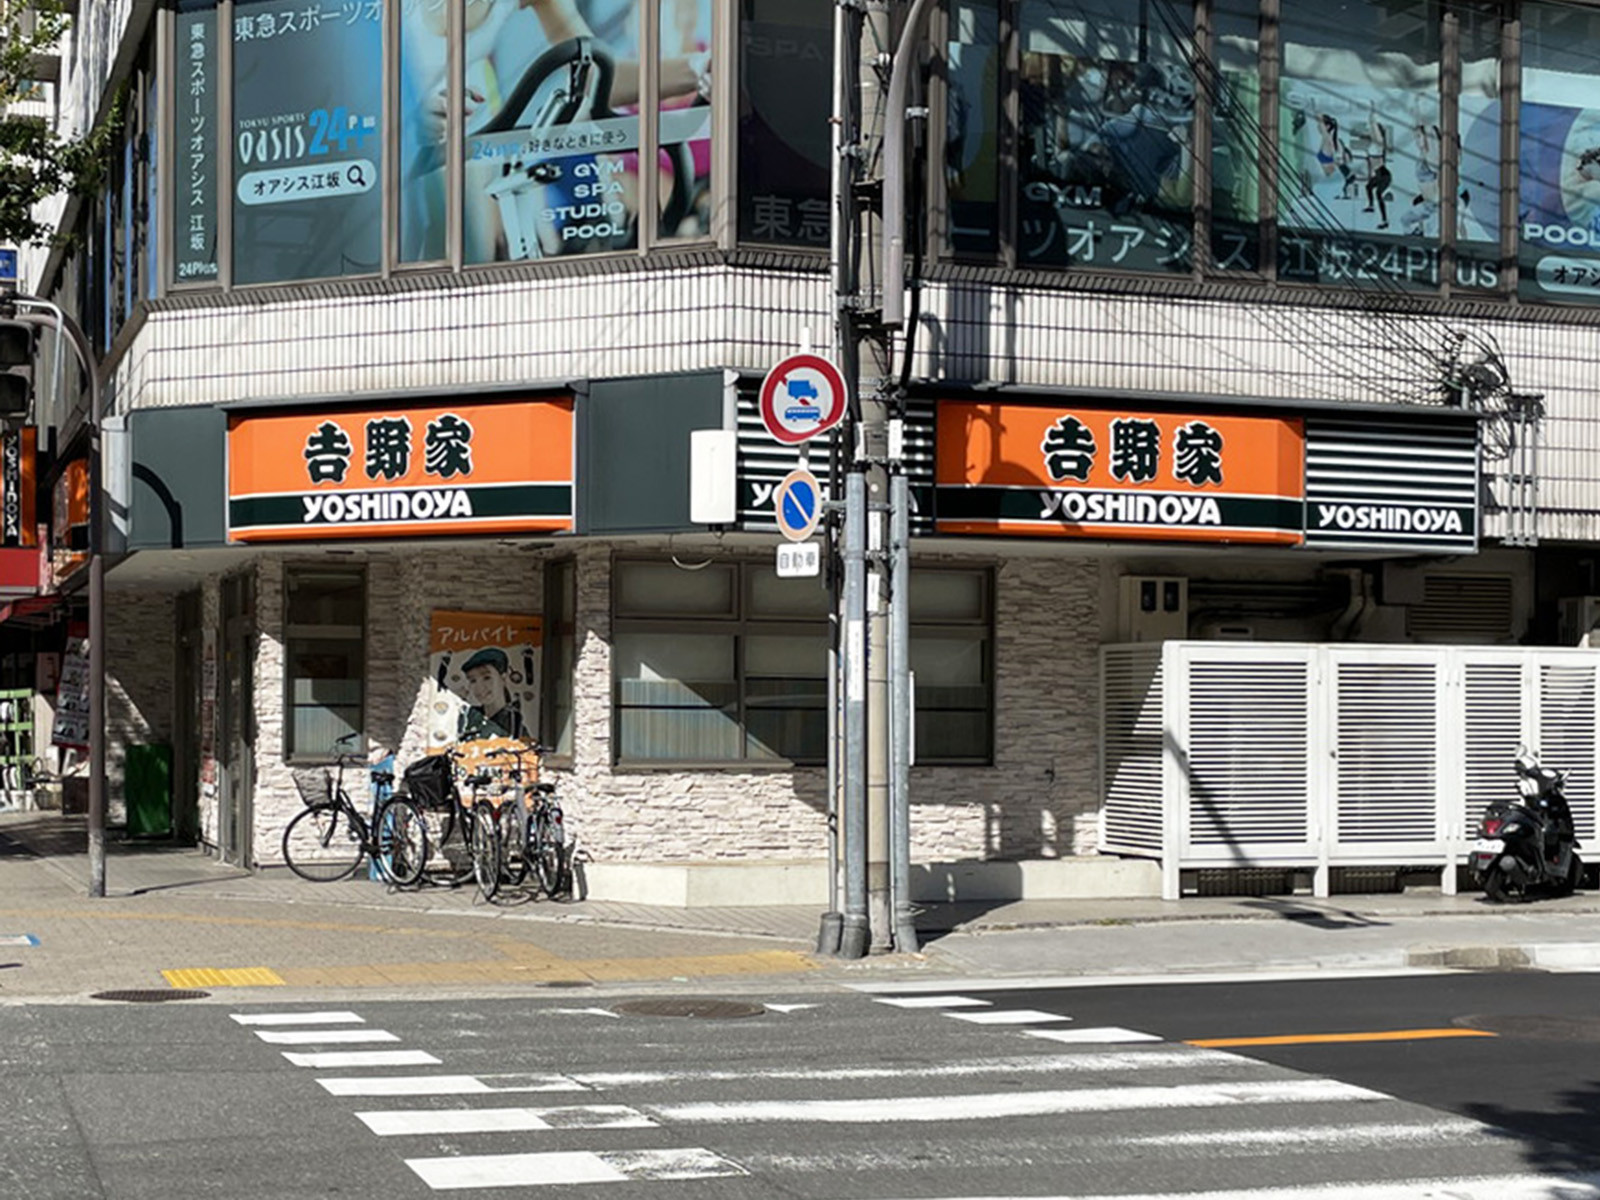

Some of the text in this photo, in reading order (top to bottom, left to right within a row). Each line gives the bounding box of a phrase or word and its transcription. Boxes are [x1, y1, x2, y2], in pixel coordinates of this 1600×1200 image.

[190, 23, 206, 250] 東急スポーツオアシス 江坂
[573, 160, 625, 178] GYM
[253, 172, 340, 196] オアシス江坂
[573, 181, 624, 199] SPA
[541, 201, 625, 221] STUDIO
[562, 224, 625, 241] POOL
[437, 624, 519, 645] アルバイト
